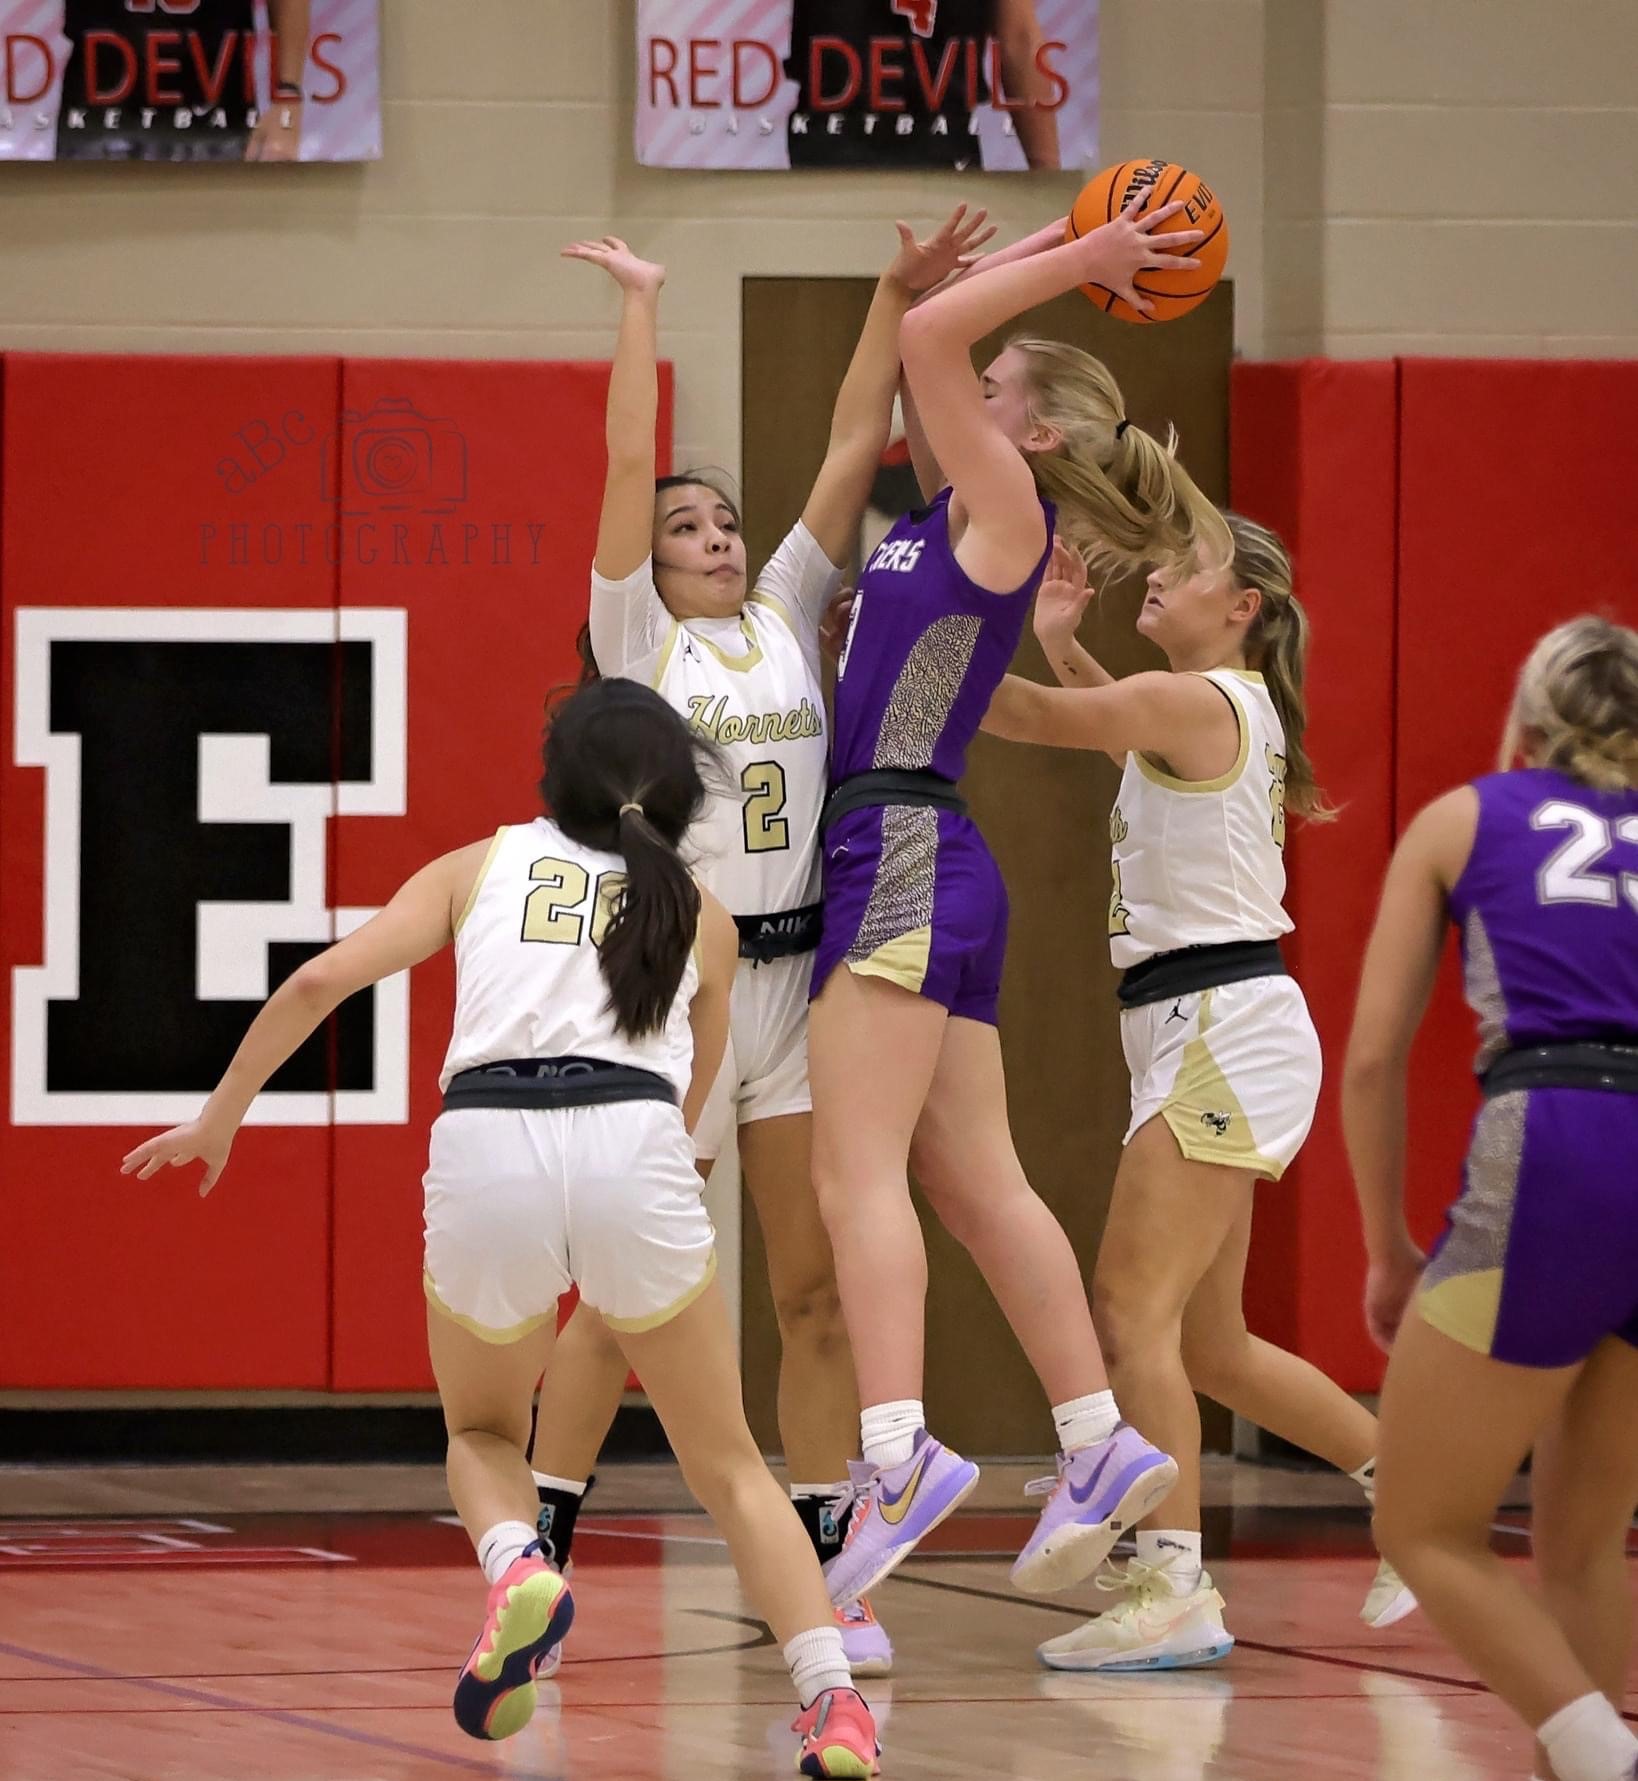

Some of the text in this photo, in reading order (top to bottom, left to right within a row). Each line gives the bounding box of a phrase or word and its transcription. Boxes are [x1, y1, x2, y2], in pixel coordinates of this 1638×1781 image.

[83, 29, 348, 107] DEVILS
[648, 34, 1070, 112] RED DEVILS
[686, 693, 824, 746] Hornets
[740, 759, 791, 855] 2
[11, 606, 409, 1125] E
[1529, 797, 1638, 918] 2
[760, 913, 814, 936] NIK
